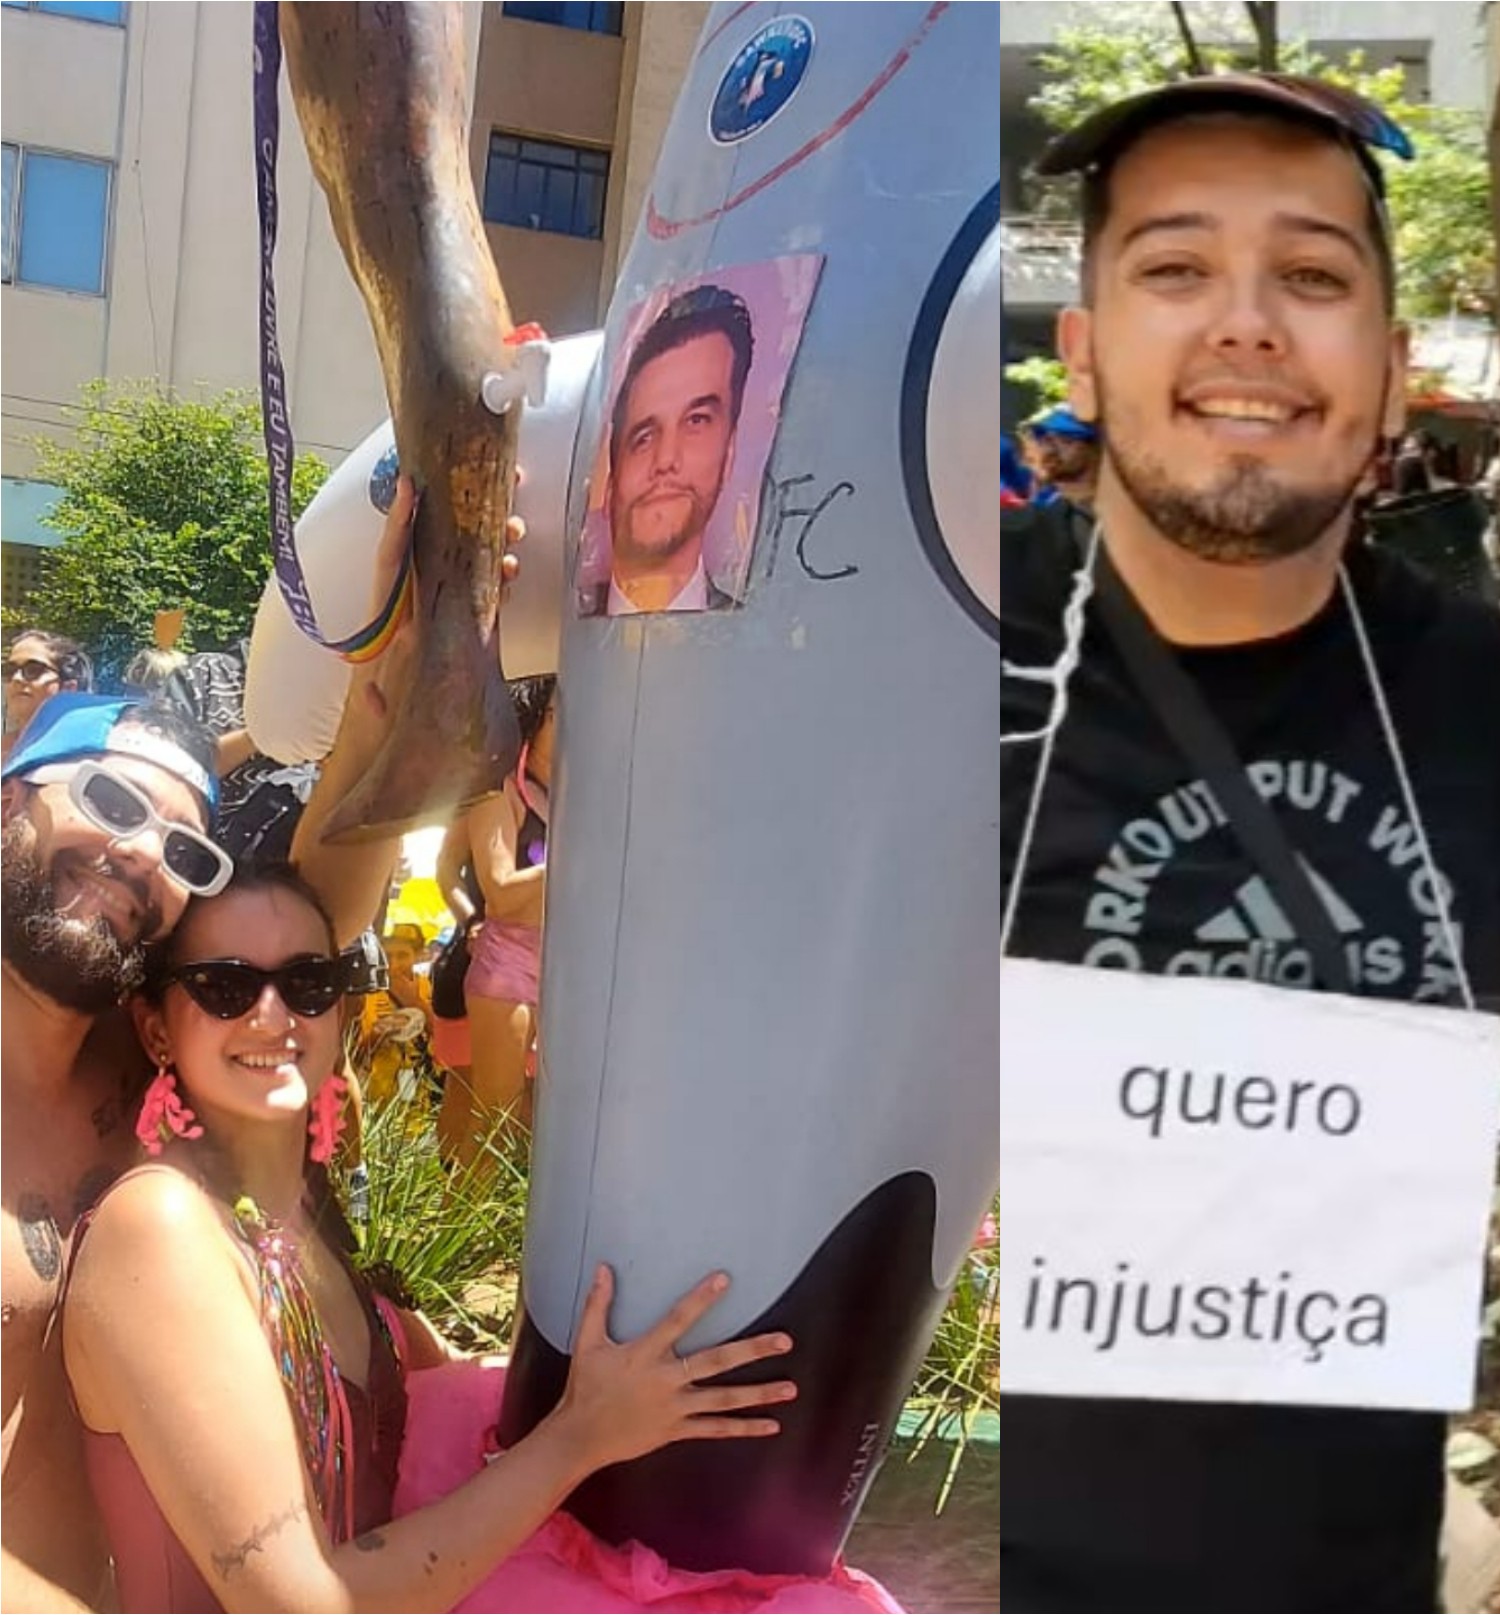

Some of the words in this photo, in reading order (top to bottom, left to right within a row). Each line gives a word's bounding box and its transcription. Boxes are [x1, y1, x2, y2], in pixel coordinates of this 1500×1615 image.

[267, 373, 281, 390] E
[269, 397, 287, 435] EU
[1083, 778, 1229, 973] ORKOUT
[1246, 760, 1362, 824] PUT
[1118, 1064, 1362, 1139] quero
[1022, 1255, 1389, 1364] injustiça
